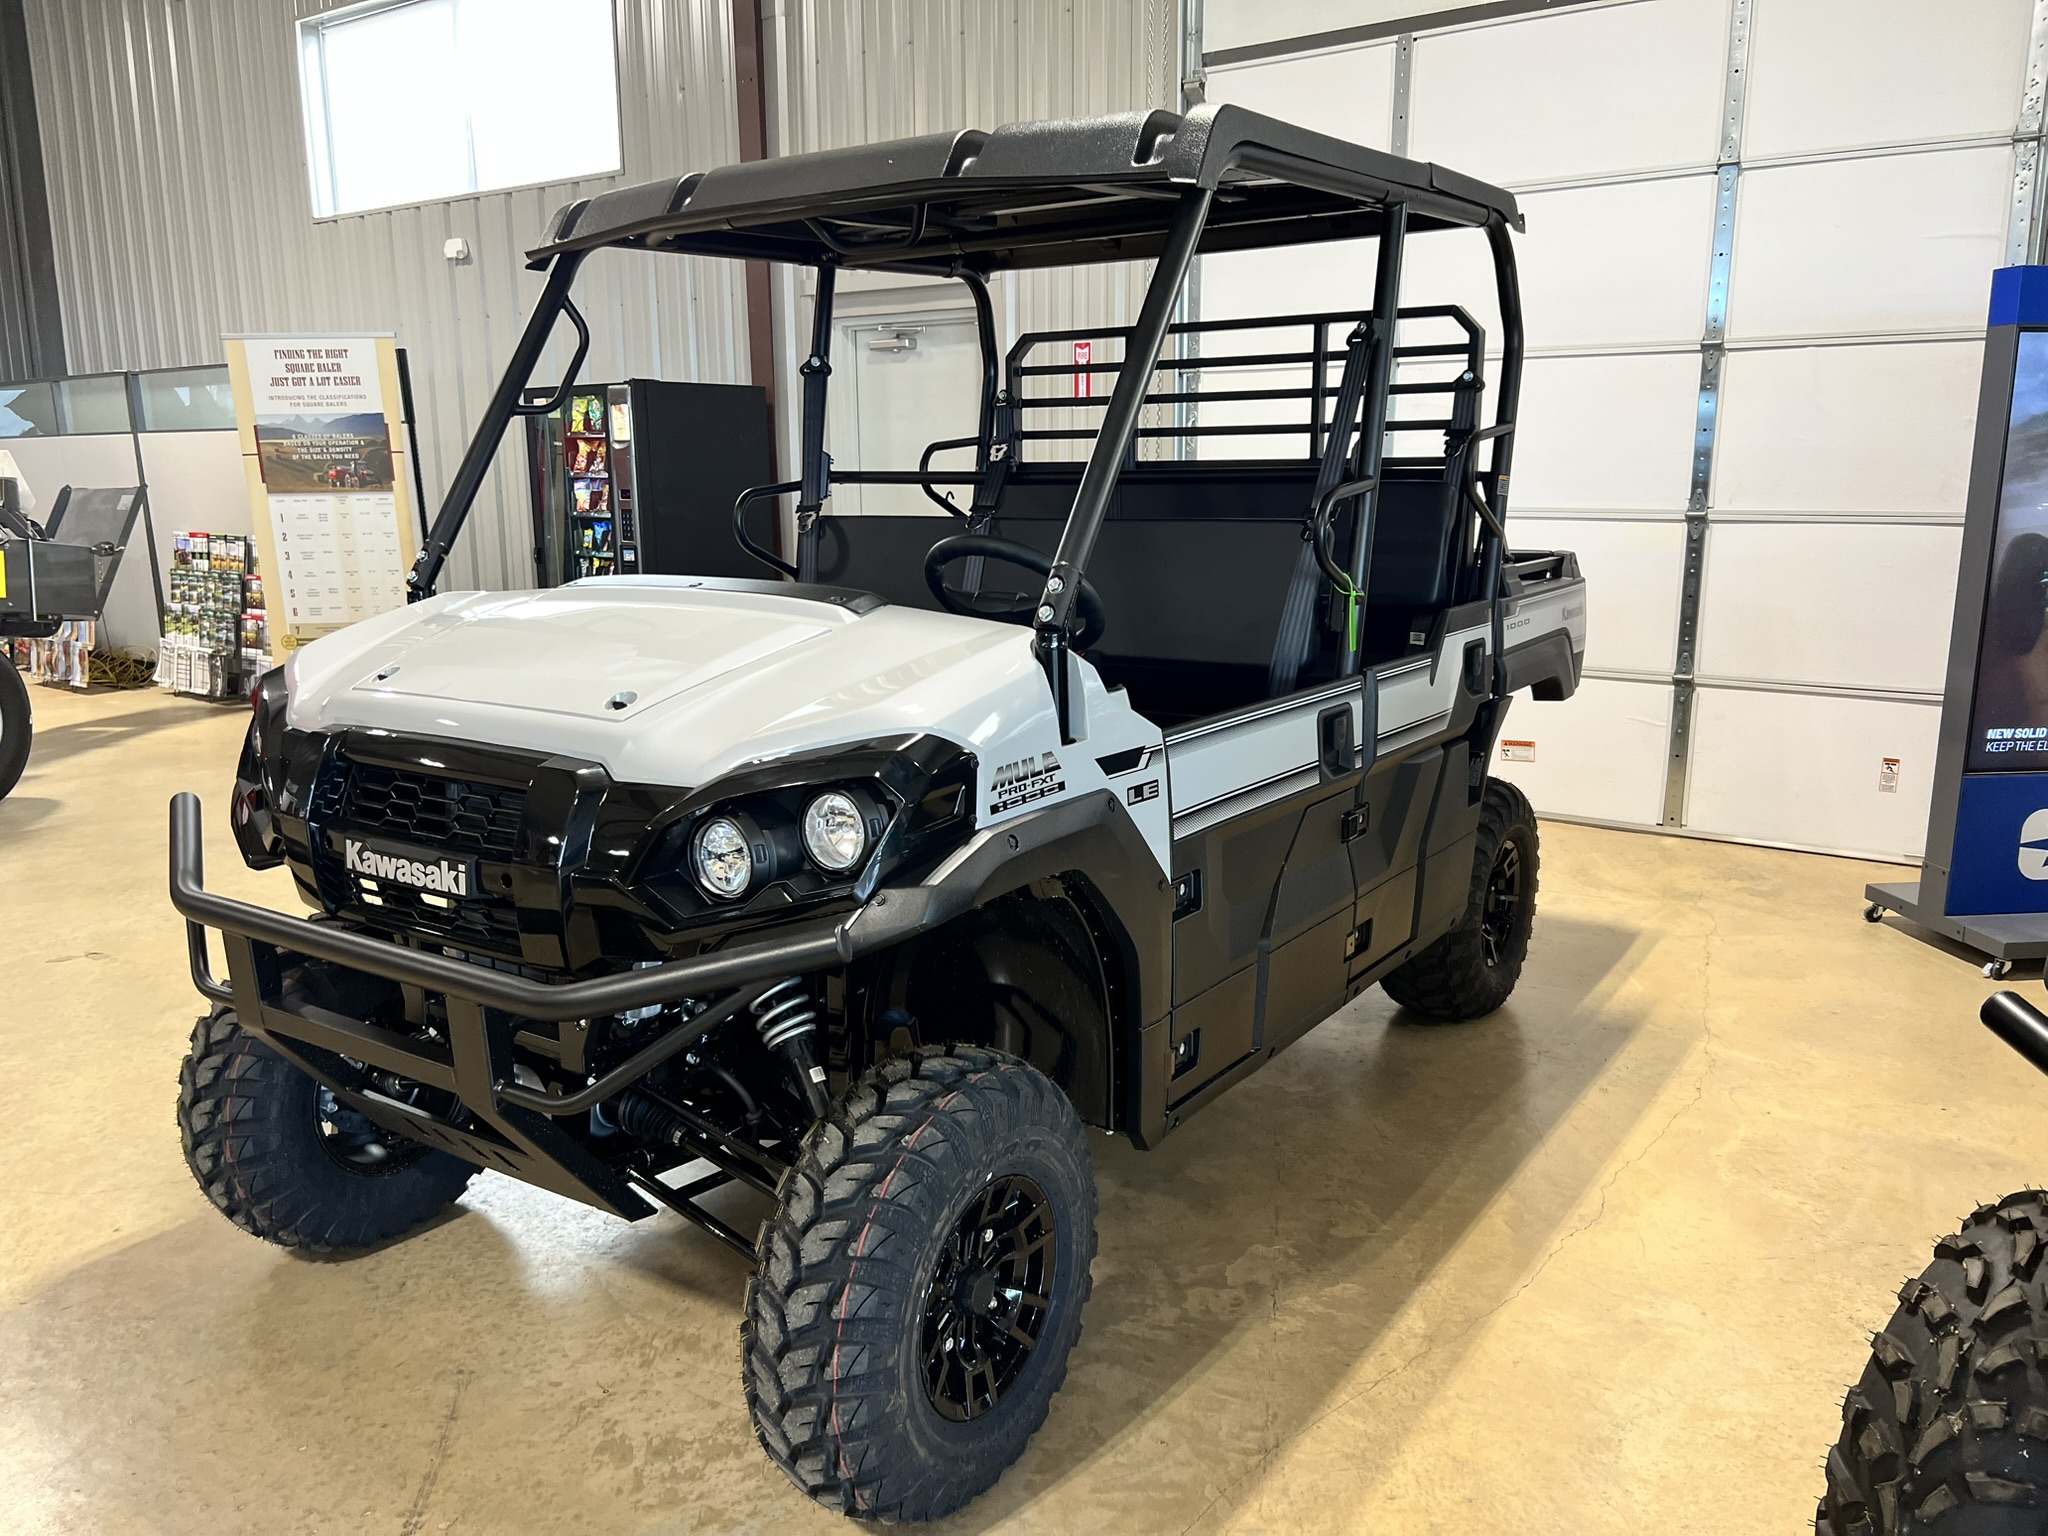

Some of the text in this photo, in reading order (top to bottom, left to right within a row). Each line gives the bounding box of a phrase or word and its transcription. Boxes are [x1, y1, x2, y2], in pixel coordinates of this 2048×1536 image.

[274, 349, 348, 359] FINDING THE RIGHT
[285, 363, 342, 374] SQUARE BALER
[270, 376, 361, 387] JUST GOT A LOT EASIER
[280, 513, 284, 523] 1
[282, 532, 288, 542] 2
[285, 551, 290, 561] 3
[288, 570, 293, 580] 4
[290, 589, 296, 598] 5
[292, 607, 298, 617] 6
[1507, 618, 1531, 630] 1000
[295, 626, 300, 635] 7
[1986, 728, 2047, 739] NEW SOLID
[1986, 741, 2015, 752] KEEP
[2016, 741, 2036, 751] THE
[991, 751, 1062, 792] MULE
[998, 773, 1056, 799] PRO-FXT
[1128, 782, 1159, 805] LE
[346, 839, 466, 896] Kawasaki
